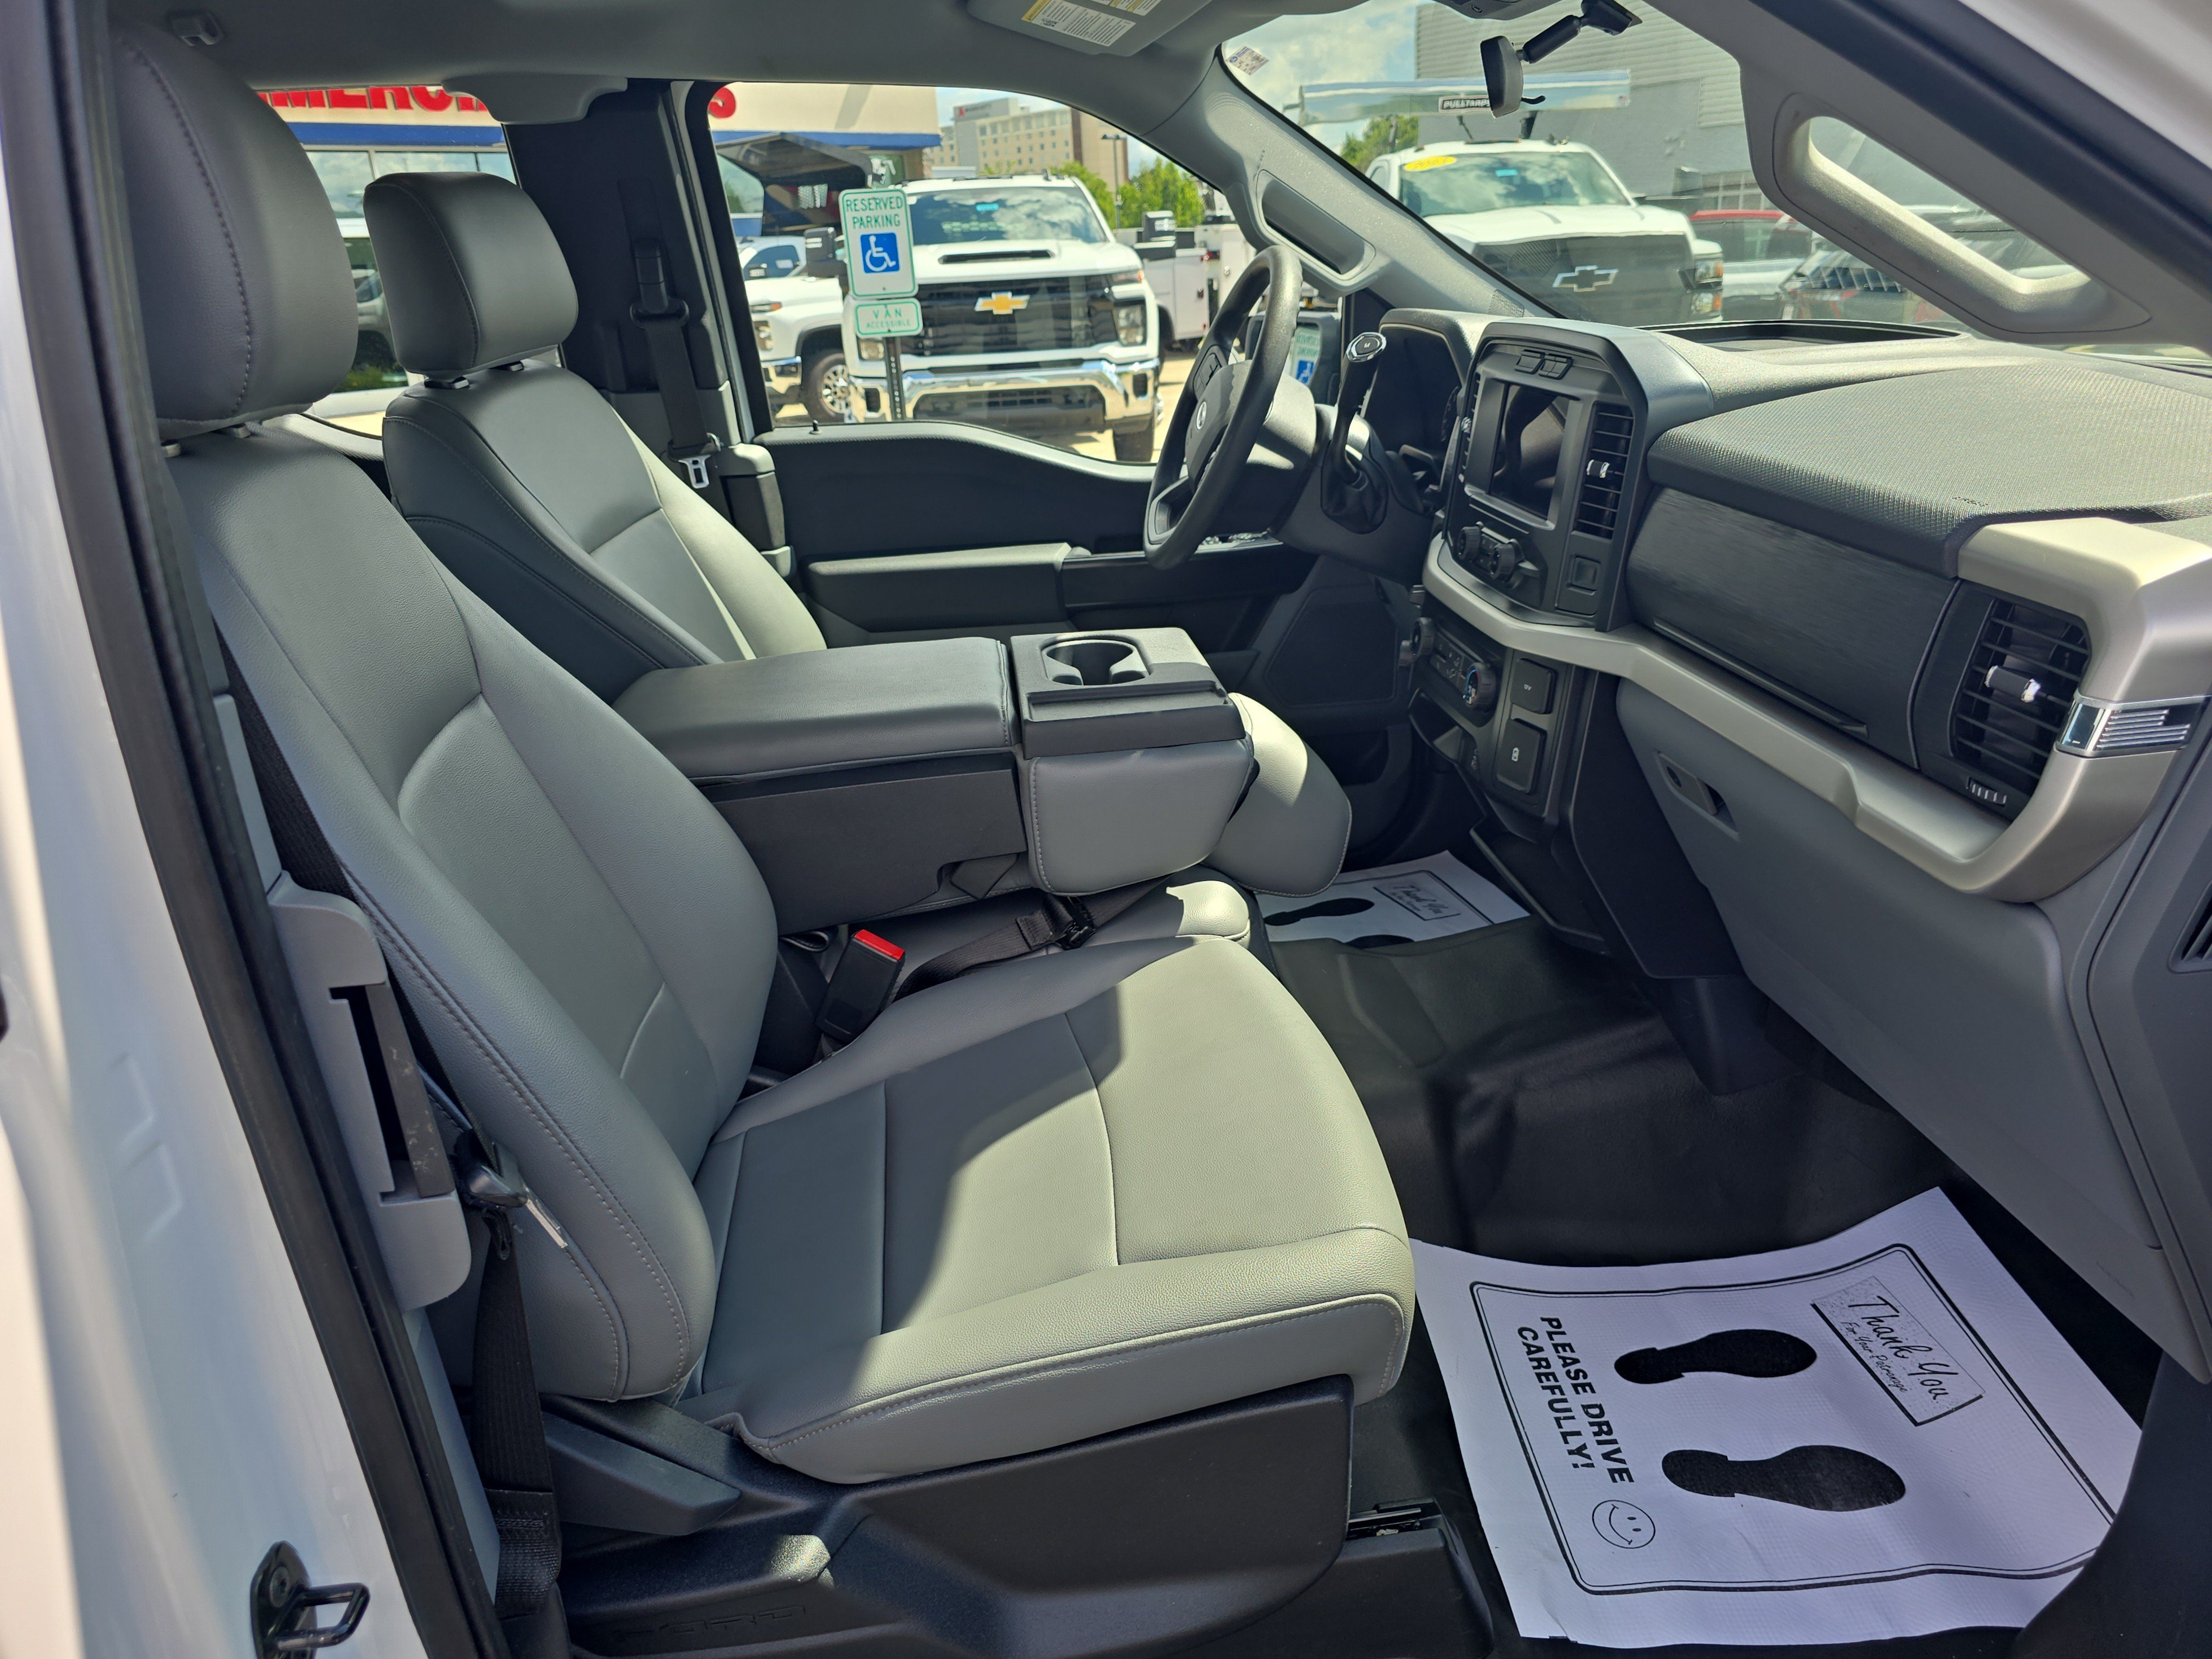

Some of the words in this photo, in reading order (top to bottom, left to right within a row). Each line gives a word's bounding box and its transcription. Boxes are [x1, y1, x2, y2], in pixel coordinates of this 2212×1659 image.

[846, 196, 903, 212] RESERVED
[852, 214, 901, 230] PARKING
[872, 307, 902, 319] VAN
[1840, 1322, 1860, 1335] For
[1854, 1336, 1874, 1354] Your
[1870, 1354, 1908, 1393] Patronage
[1848, 1295, 1933, 1359] Thank
[1907, 1362, 1959, 1400] You
[1517, 1327, 1595, 1468] CAREFULLY!
[1540, 1317, 1596, 1394] PLEASE
[1580, 1403, 1634, 1483] DRIVE
